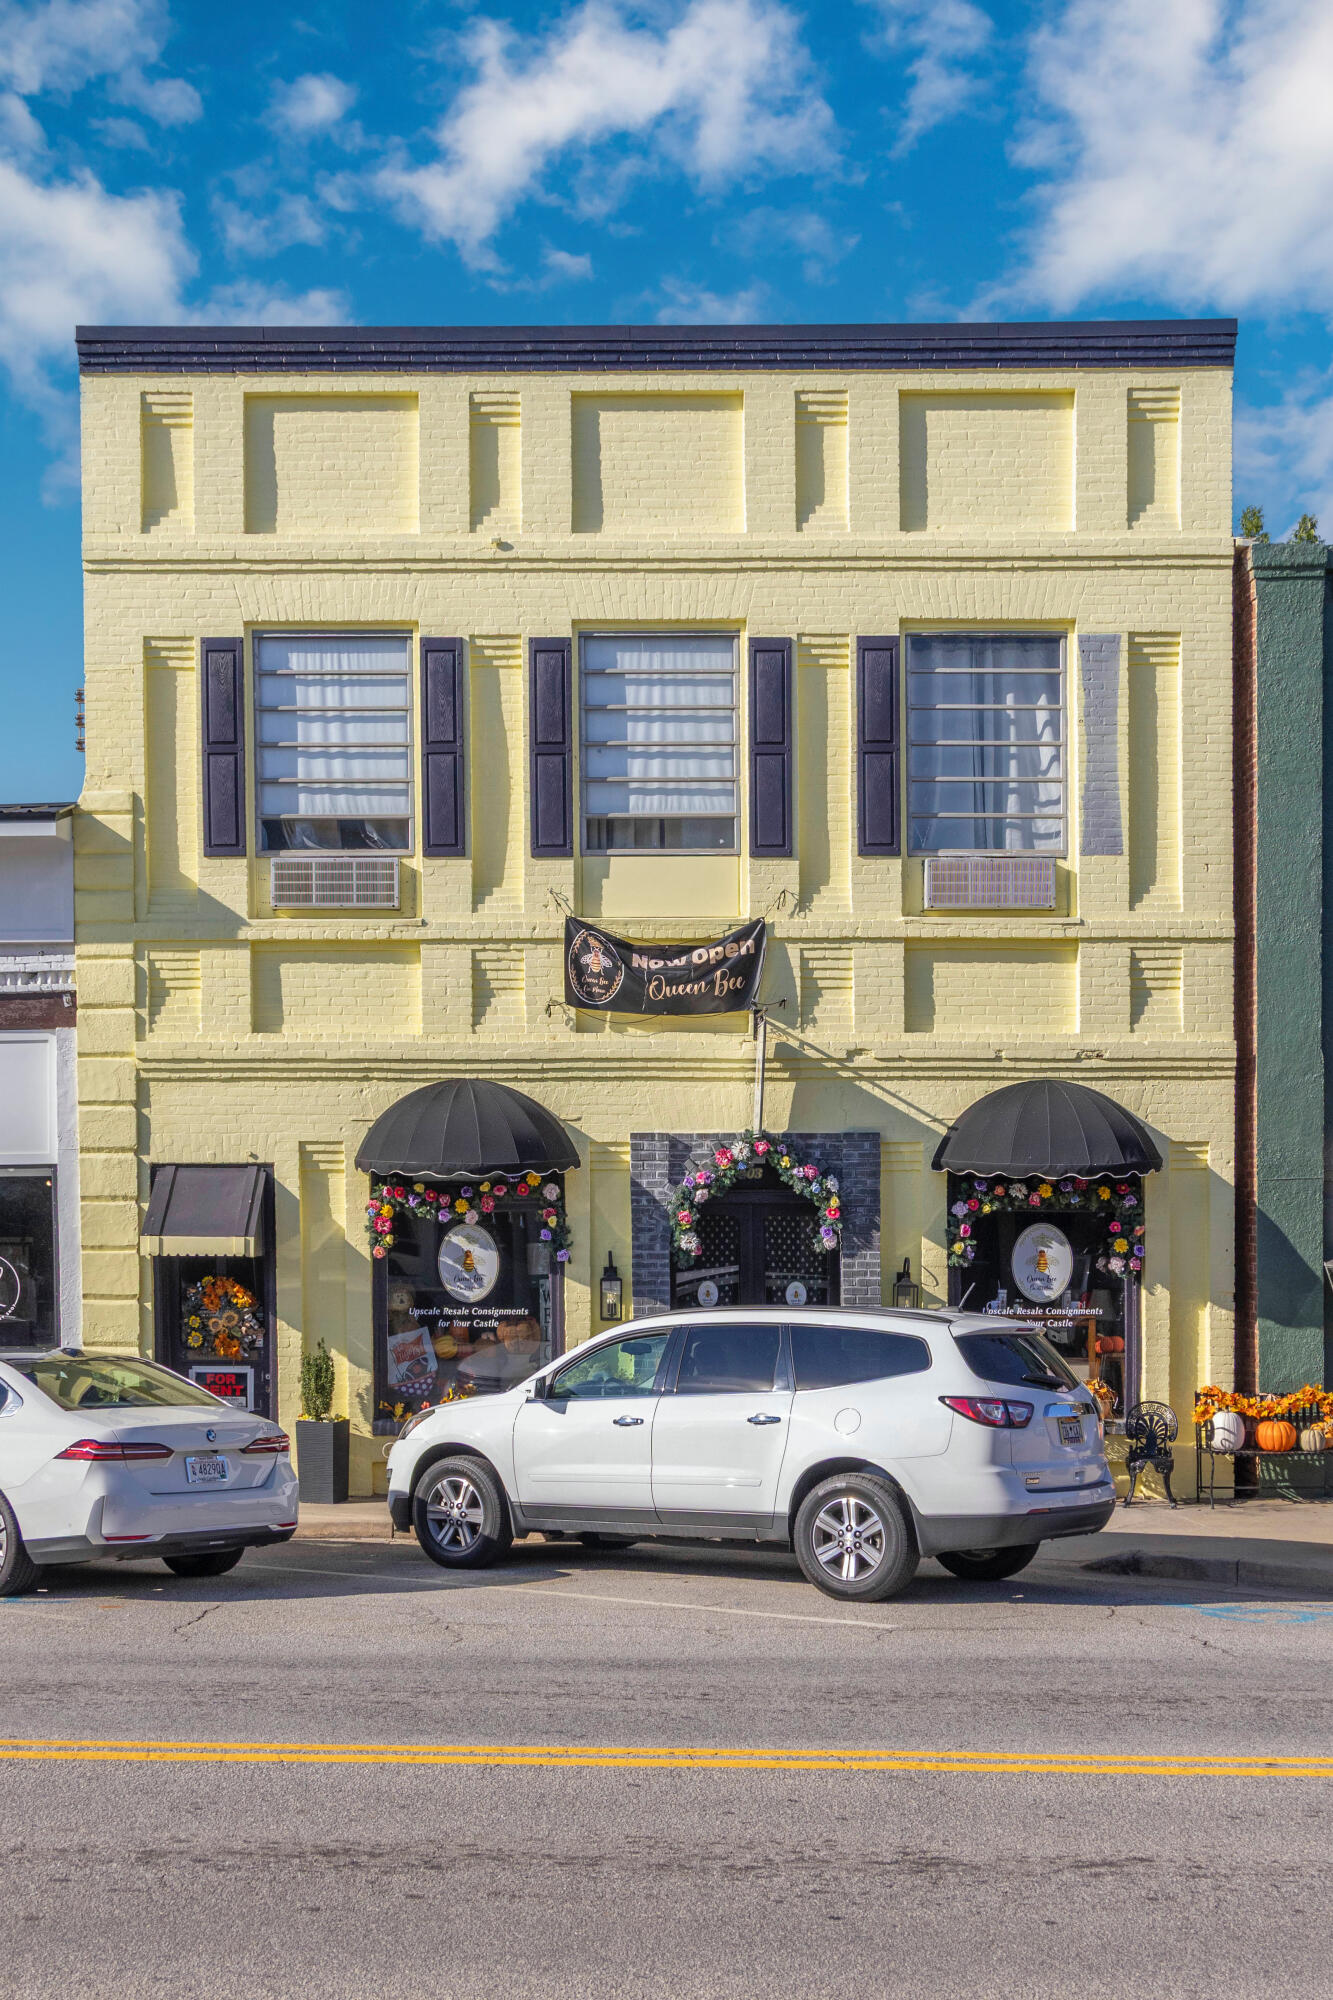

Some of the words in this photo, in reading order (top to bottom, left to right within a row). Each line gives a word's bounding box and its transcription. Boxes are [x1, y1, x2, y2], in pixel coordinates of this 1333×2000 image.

[632, 953, 687, 971] Now
[691, 939, 755, 965] Open
[649, 974, 710, 1000] Queen
[713, 968, 746, 998] Bee
[409, 1307, 440, 1318] Upscale
[443, 1307, 469, 1316] Resale
[472, 1307, 529, 1318] Consignments
[1016, 1307, 1043, 1316] Resale
[1046, 1307, 1103, 1318] Consignments
[438, 1319, 450, 1328] for
[452, 1319, 471, 1328] Your
[473, 1319, 499, 1328] Castle
[542, 1290, 552, 1360] WELC
[1026, 1319, 1044, 1328] Your
[1047, 1319, 1073, 1328] Castle
[206, 1374, 236, 1384] FOR
